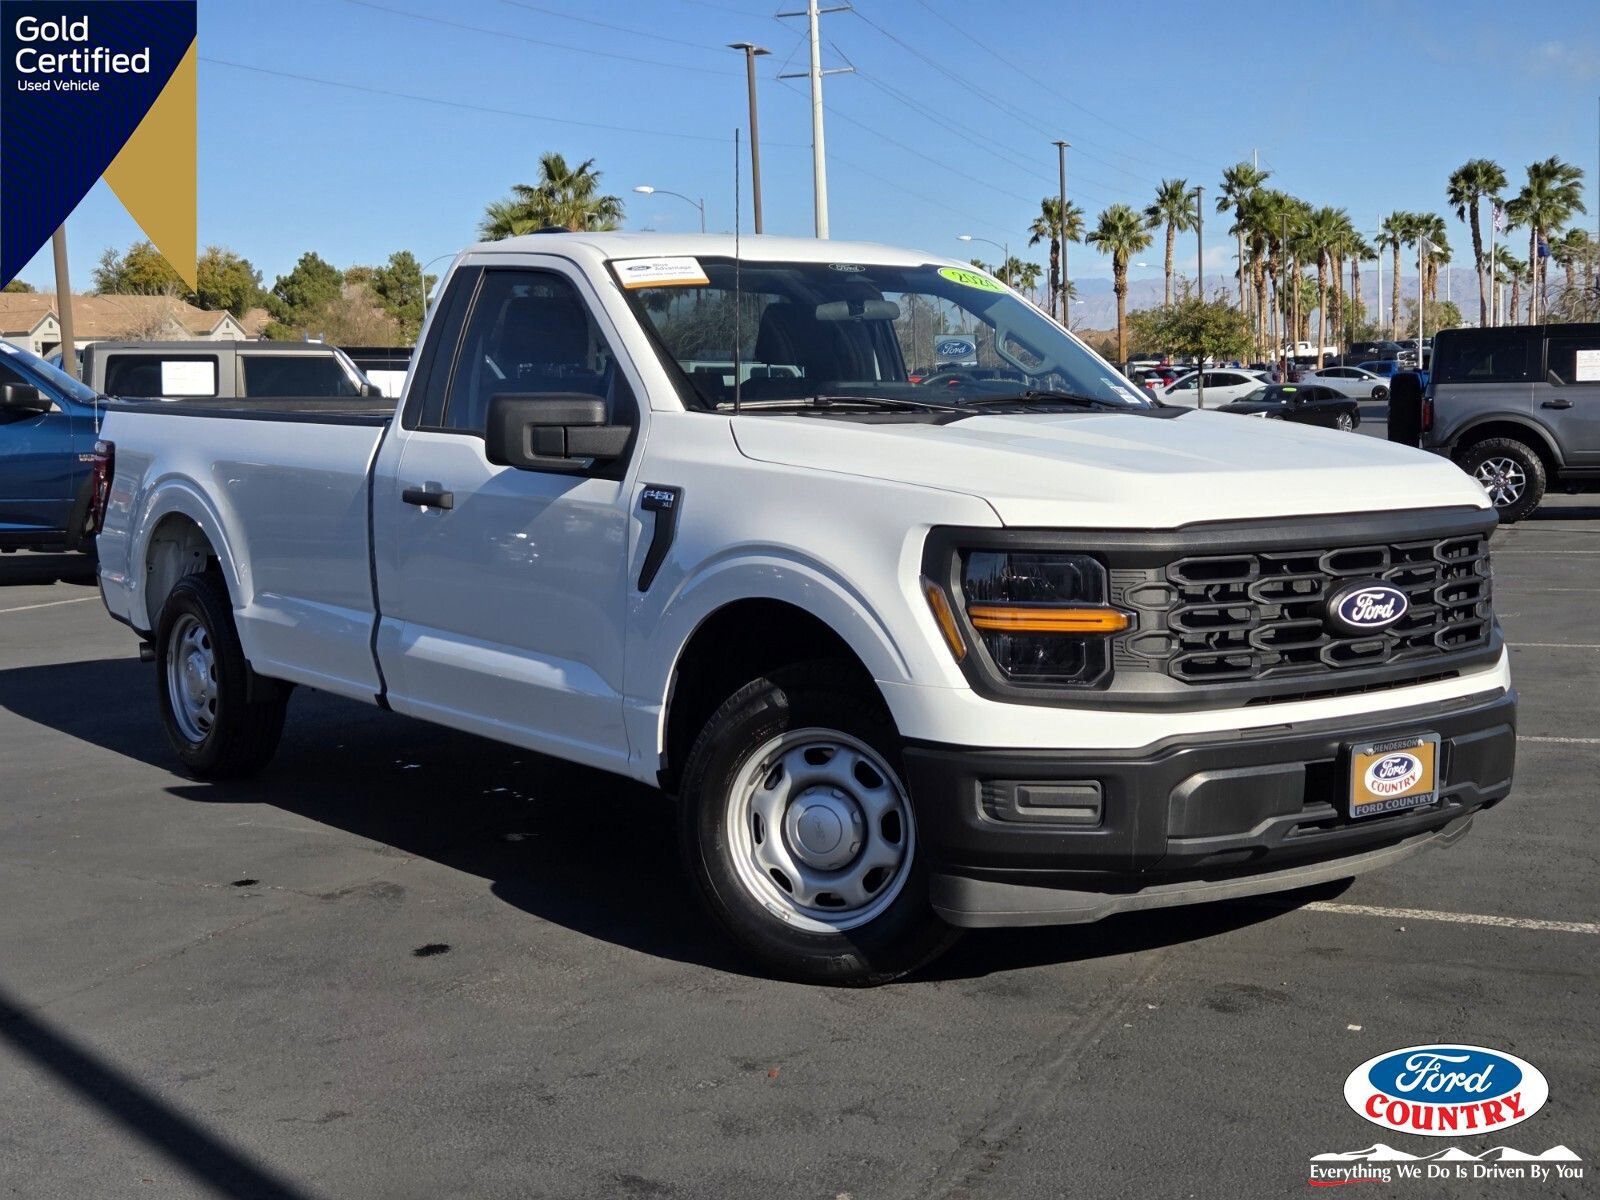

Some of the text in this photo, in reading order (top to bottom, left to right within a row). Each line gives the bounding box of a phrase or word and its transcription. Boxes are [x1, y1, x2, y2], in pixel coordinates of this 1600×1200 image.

[941, 342, 968, 356] Ford
[1352, 592, 1396, 621] Ford
[1373, 739, 1418, 752] HENDERSON
[1380, 757, 1408, 778] Ford
[1371, 772, 1417, 794] COUNTRY
[1356, 793, 1433, 815] FORD COUNTRY
